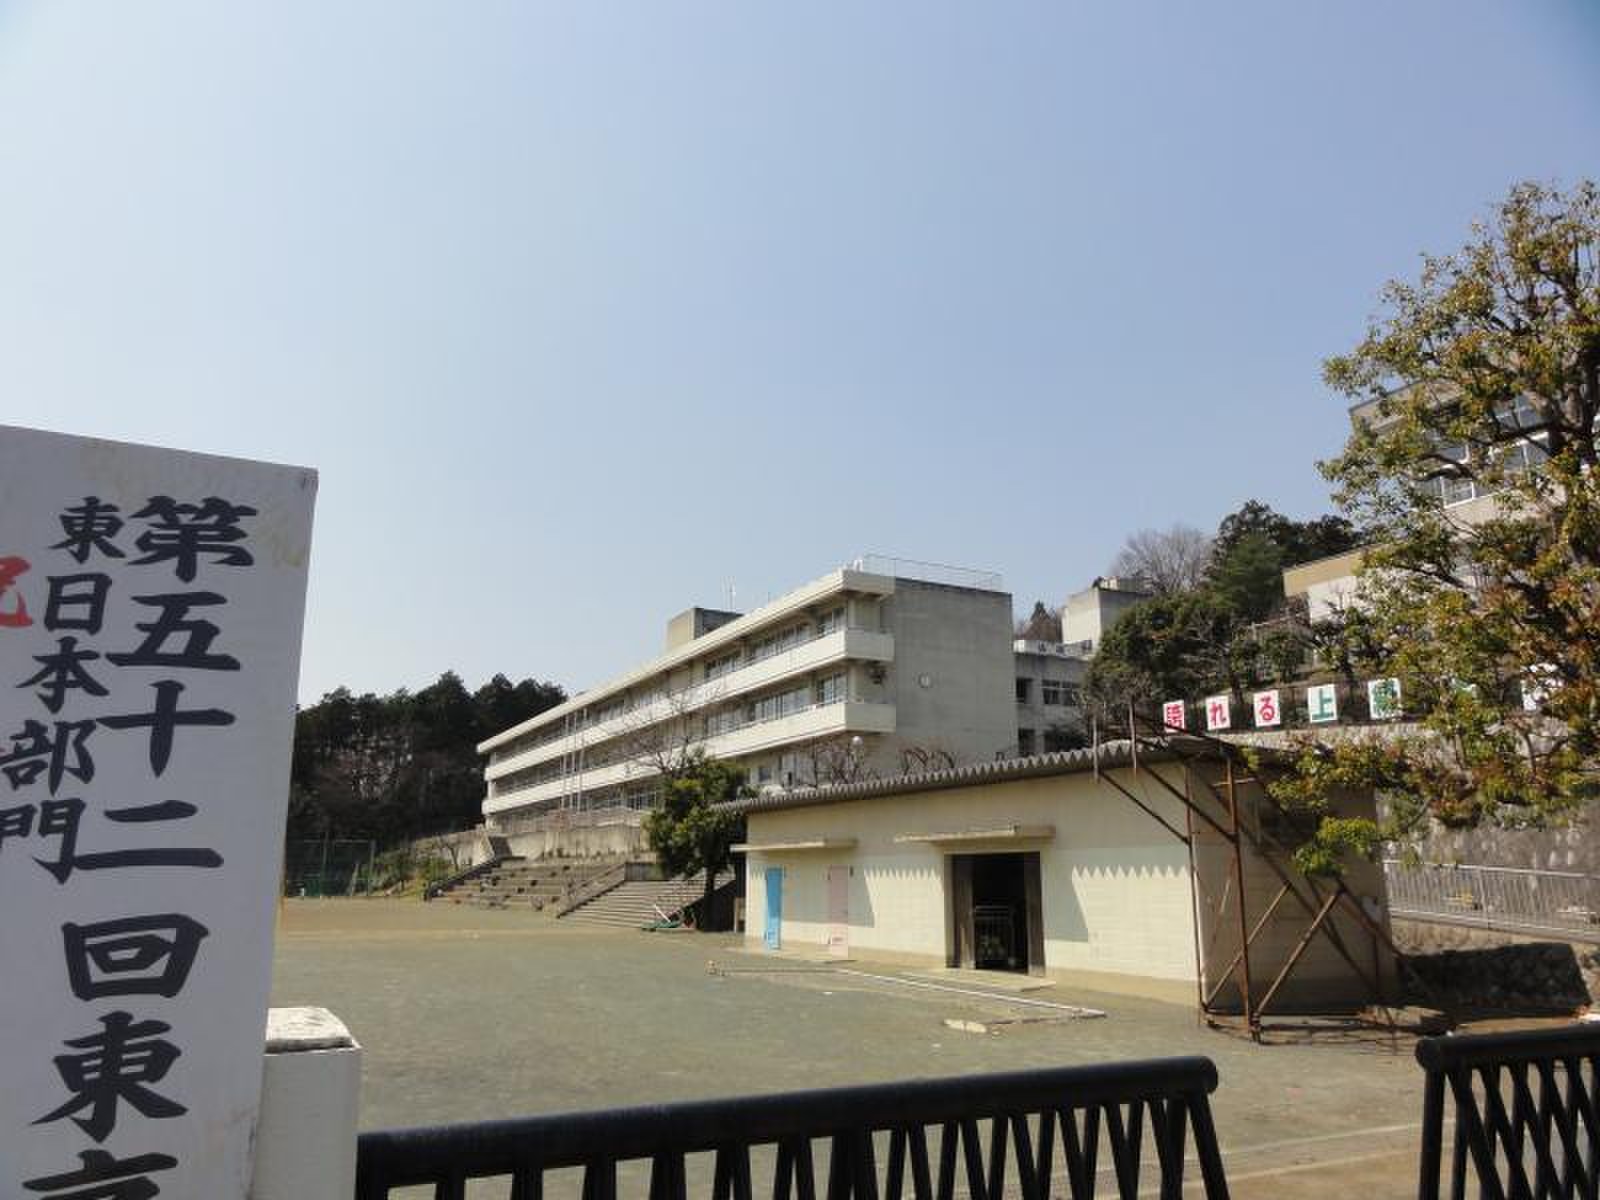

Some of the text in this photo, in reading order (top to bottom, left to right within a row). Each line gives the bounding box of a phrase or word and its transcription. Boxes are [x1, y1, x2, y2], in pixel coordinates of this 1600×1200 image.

[0, 496, 127, 885] 東日本部門
